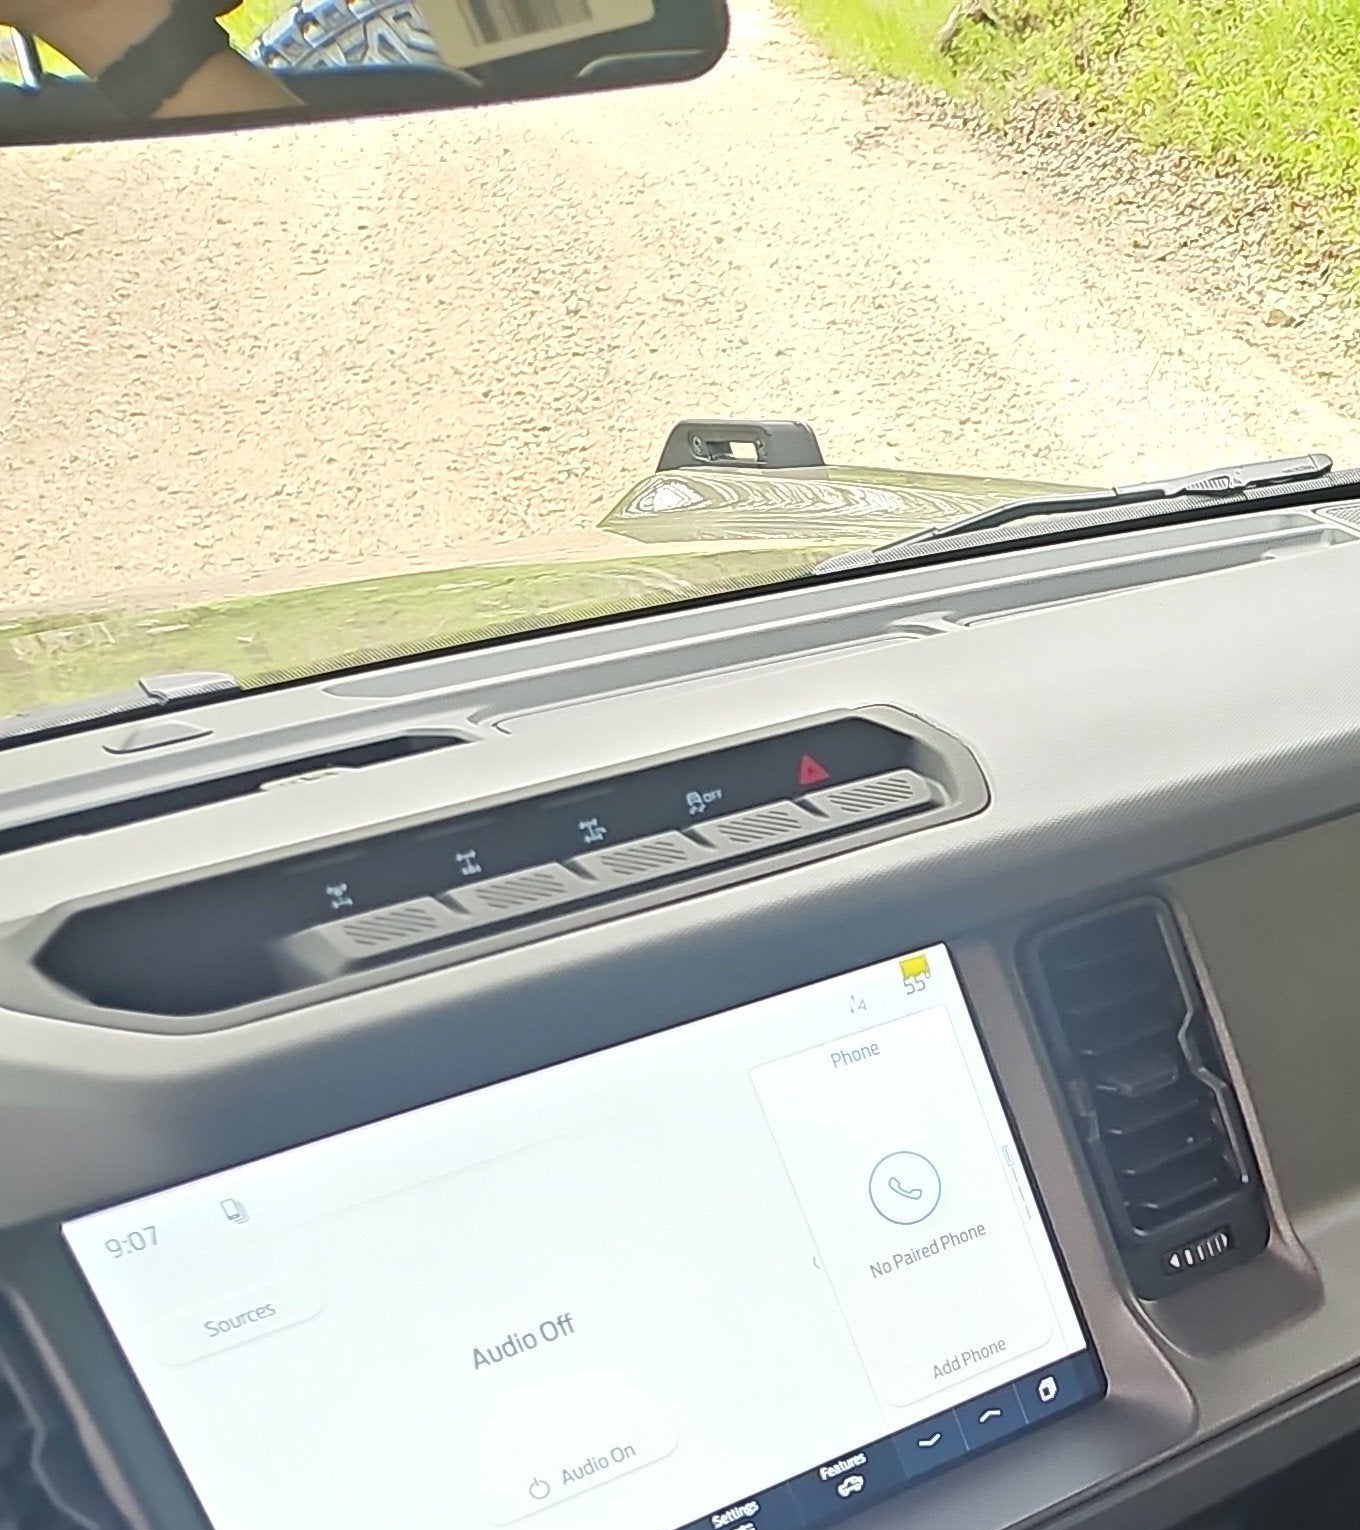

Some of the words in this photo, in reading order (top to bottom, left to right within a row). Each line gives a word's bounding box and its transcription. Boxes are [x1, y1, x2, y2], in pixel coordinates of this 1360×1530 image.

[702, 789, 722, 803] OFF
[830, 1040, 881, 1069] Phone
[105, 1225, 160, 1258] 9:07
[869, 1257, 893, 1279] No
[893, 1238, 940, 1270] Paired
[938, 1221, 987, 1253] Phone
[203, 1301, 277, 1338] Sources
[471, 1328, 538, 1370] Audio
[539, 1312, 577, 1343] Off
[932, 1354, 962, 1380] Add
[961, 1336, 1007, 1368] Phone
[560, 1455, 609, 1487] Audio
[610, 1442, 637, 1468] On
[818, 1451, 867, 1480] Features
[711, 1499, 760, 1530] Settings
